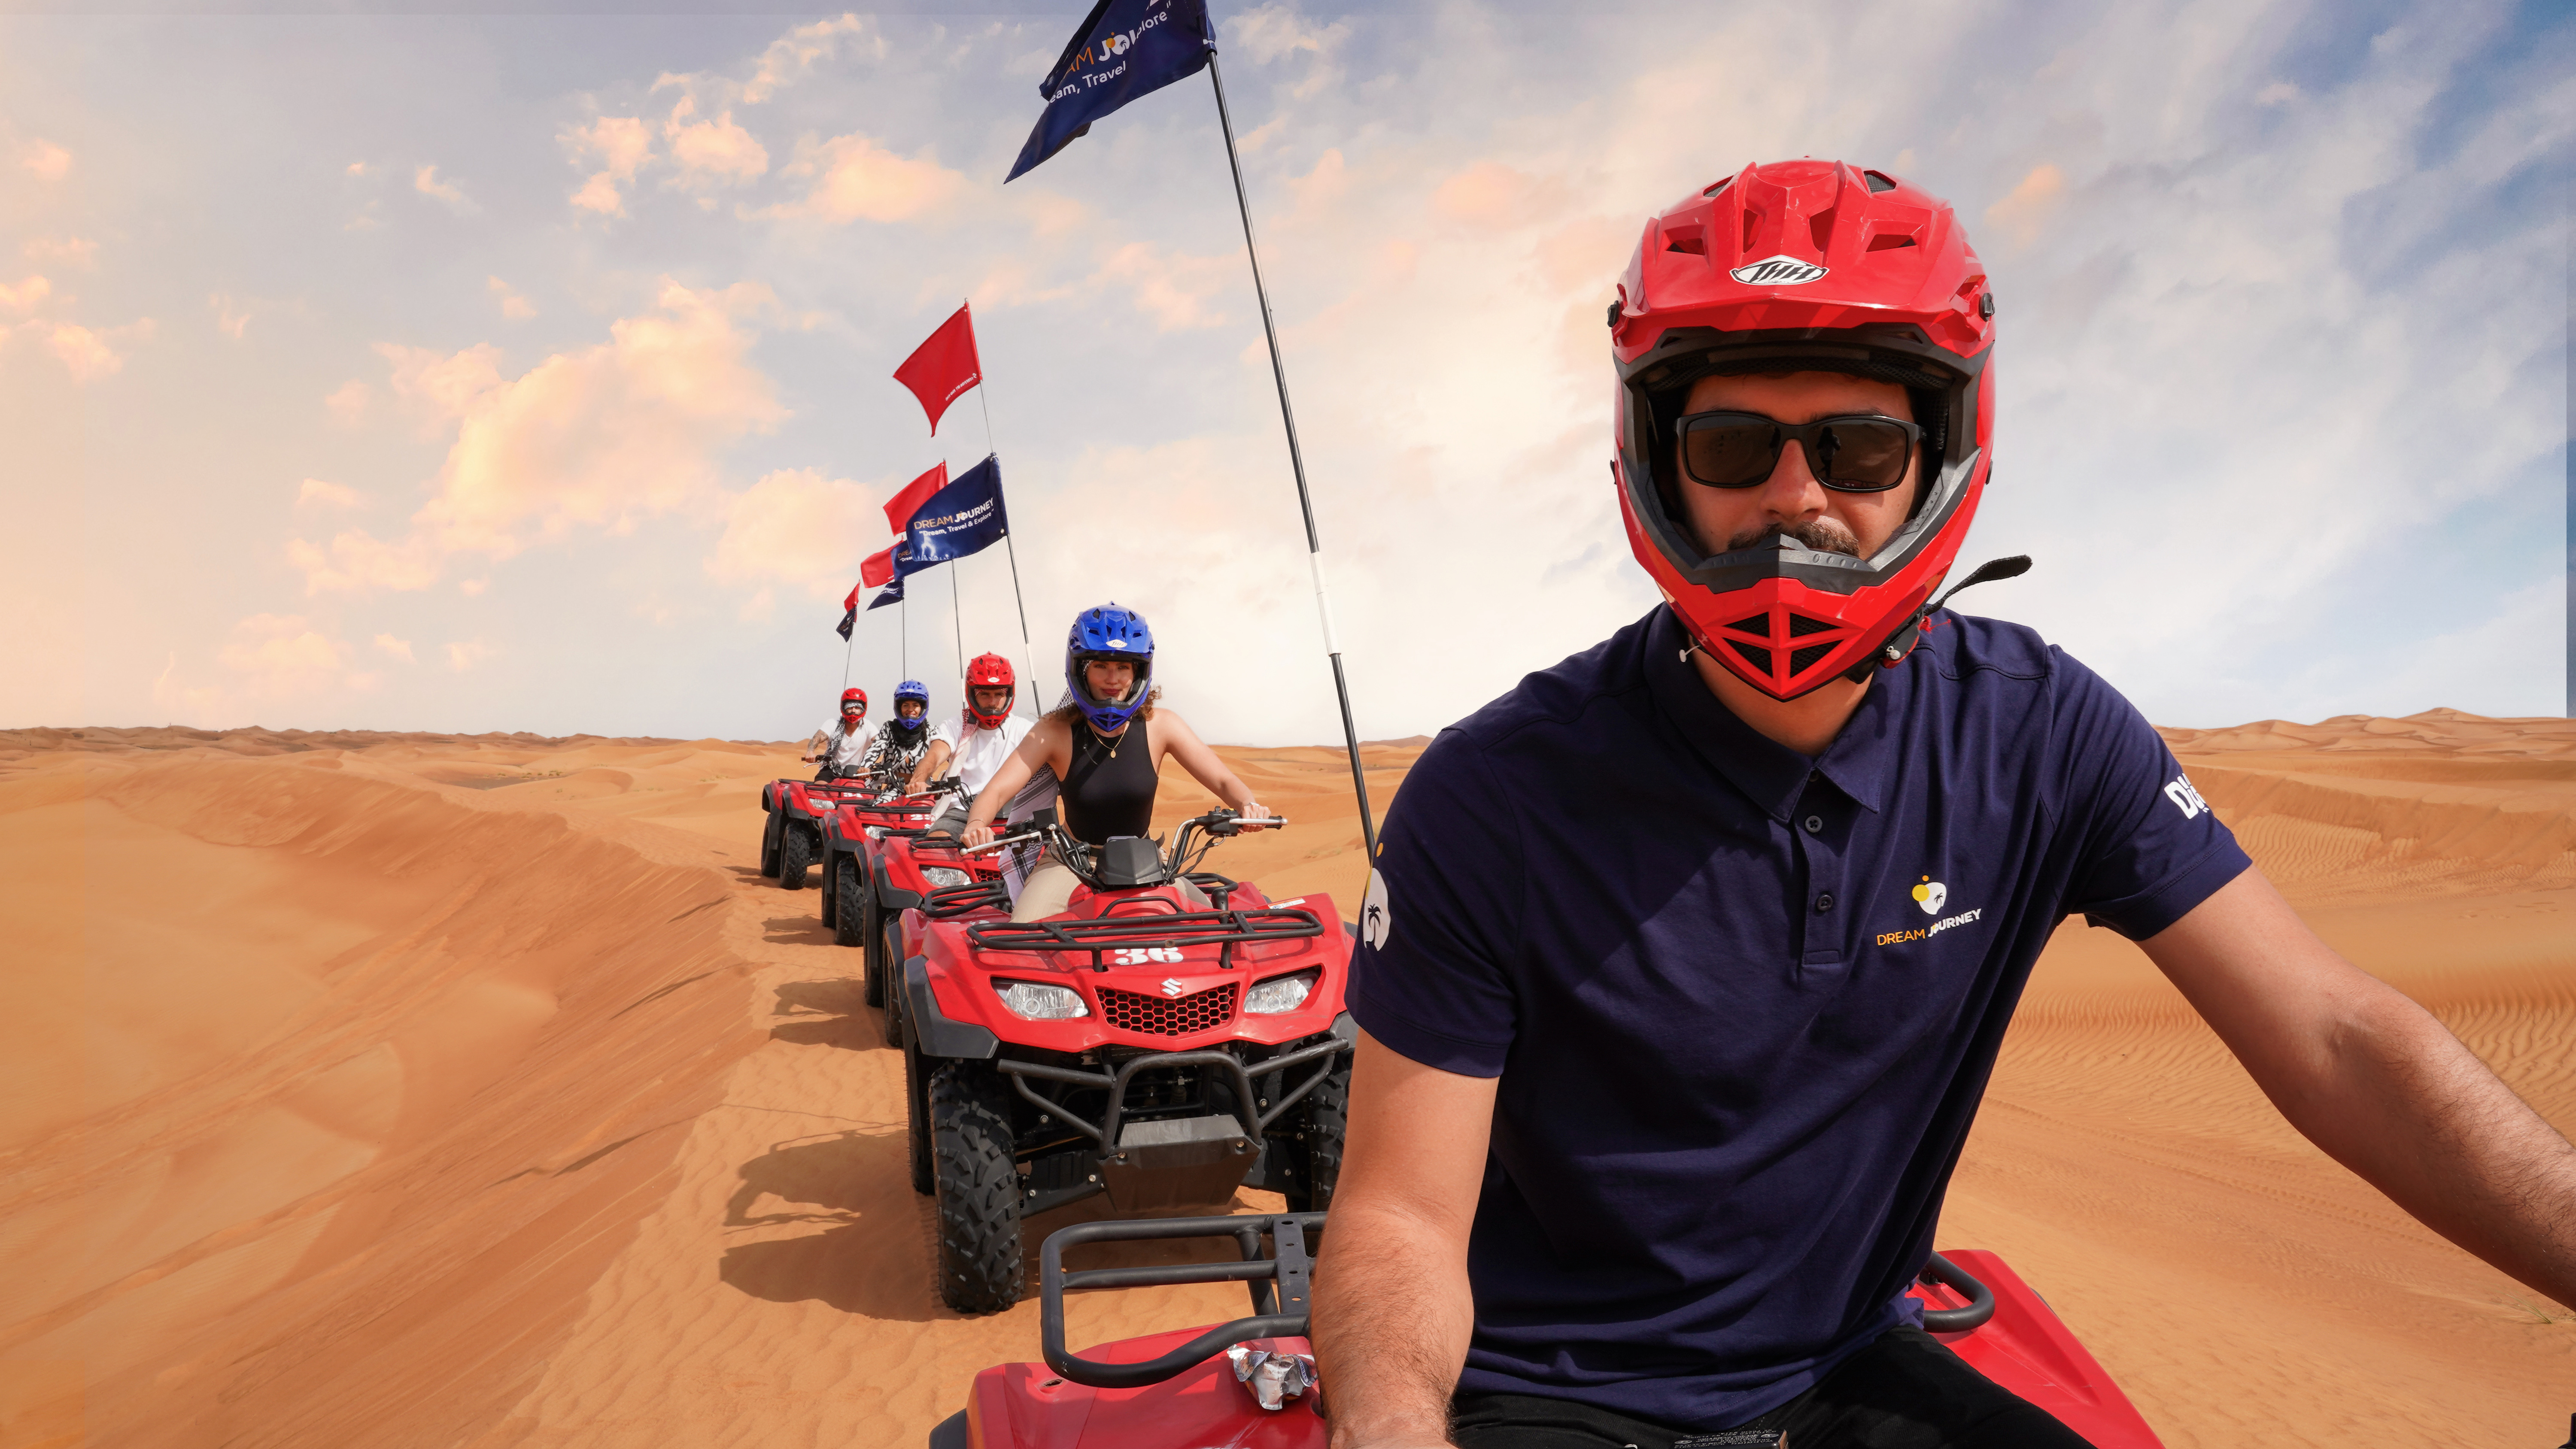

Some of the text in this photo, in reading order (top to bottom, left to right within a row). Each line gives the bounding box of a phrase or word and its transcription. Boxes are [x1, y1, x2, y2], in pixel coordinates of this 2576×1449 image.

[1049, 61, 1126, 103] eam, Travel
[914, 497, 993, 530] DREAM JOURNEY
[947, 523, 967, 532] Travel
[1877, 908, 1981, 946] DREAM JOURNEY
[1115, 947, 1184, 965] 36
